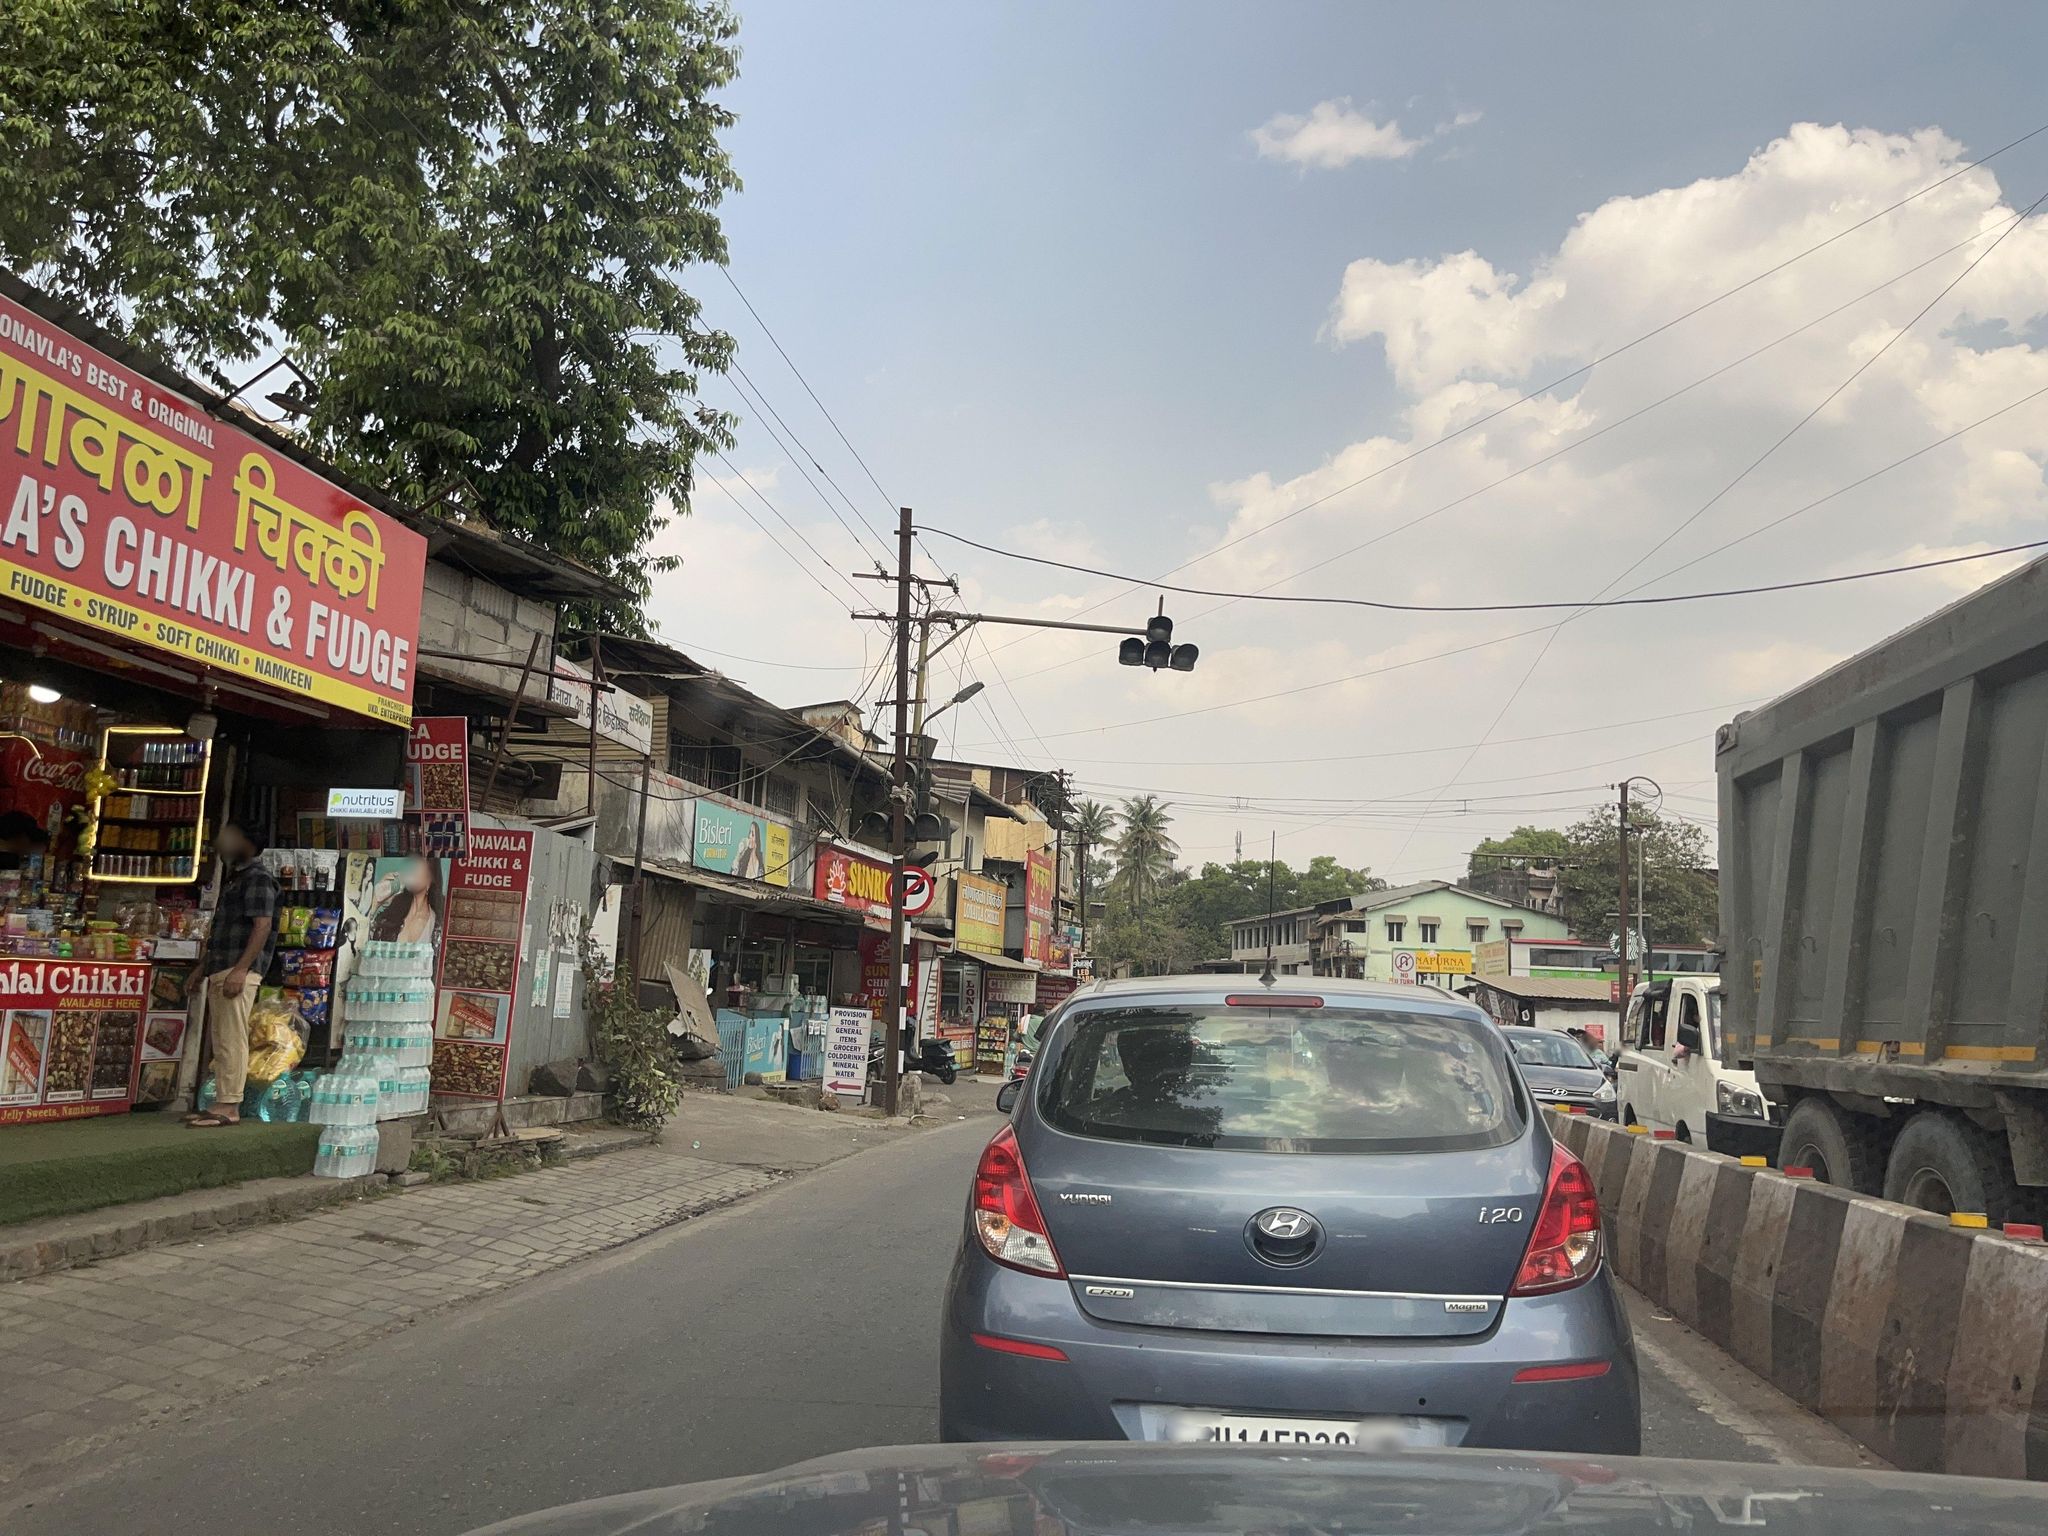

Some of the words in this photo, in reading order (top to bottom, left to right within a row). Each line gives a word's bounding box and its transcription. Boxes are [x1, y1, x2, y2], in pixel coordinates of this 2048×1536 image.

[86, 362, 129, 401] BEST
[131, 388, 144, 412] &
[148, 397, 215, 450] ORIGINAL
[233, 452, 386, 612] चिक्की
[0, 474, 89, 569] A'S
[104, 516, 255, 633] CHIKKI
[266, 585, 294, 650] &
[306, 600, 410, 691] FUDGE
[11, 570, 68, 608] FUDGE
[87, 598, 139, 631] SYRUP
[157, 623, 193, 651] SOFT
[195, 636, 240, 666] CHIKKI
[255, 656, 313, 691] NAMKEEN
[378, 696, 404, 713] FRANCHISE
[342, 794, 394, 806] nutritius
[699, 817, 733, 846] Bisleri
[512, 858, 522, 870] &
[465, 873, 513, 887] FUDGE
[50, 966, 145, 995] Chikki
[59, 998, 113, 1008] AVAILABLE
[116, 998, 141, 1009] HERE
[834, 1010, 867, 1018] PROVISION
[833, 1044, 861, 1052] GROCERY
[827, 1052, 866, 1061] COLDDRINKS
[832, 1061, 859, 1069] MINERAL
[835, 1070, 855, 1078] WATER
[1, 1109, 24, 1121] Jelly
[1088, 1288, 1131, 1297] CRDi
[1448, 1303, 1486, 1312] Magna
